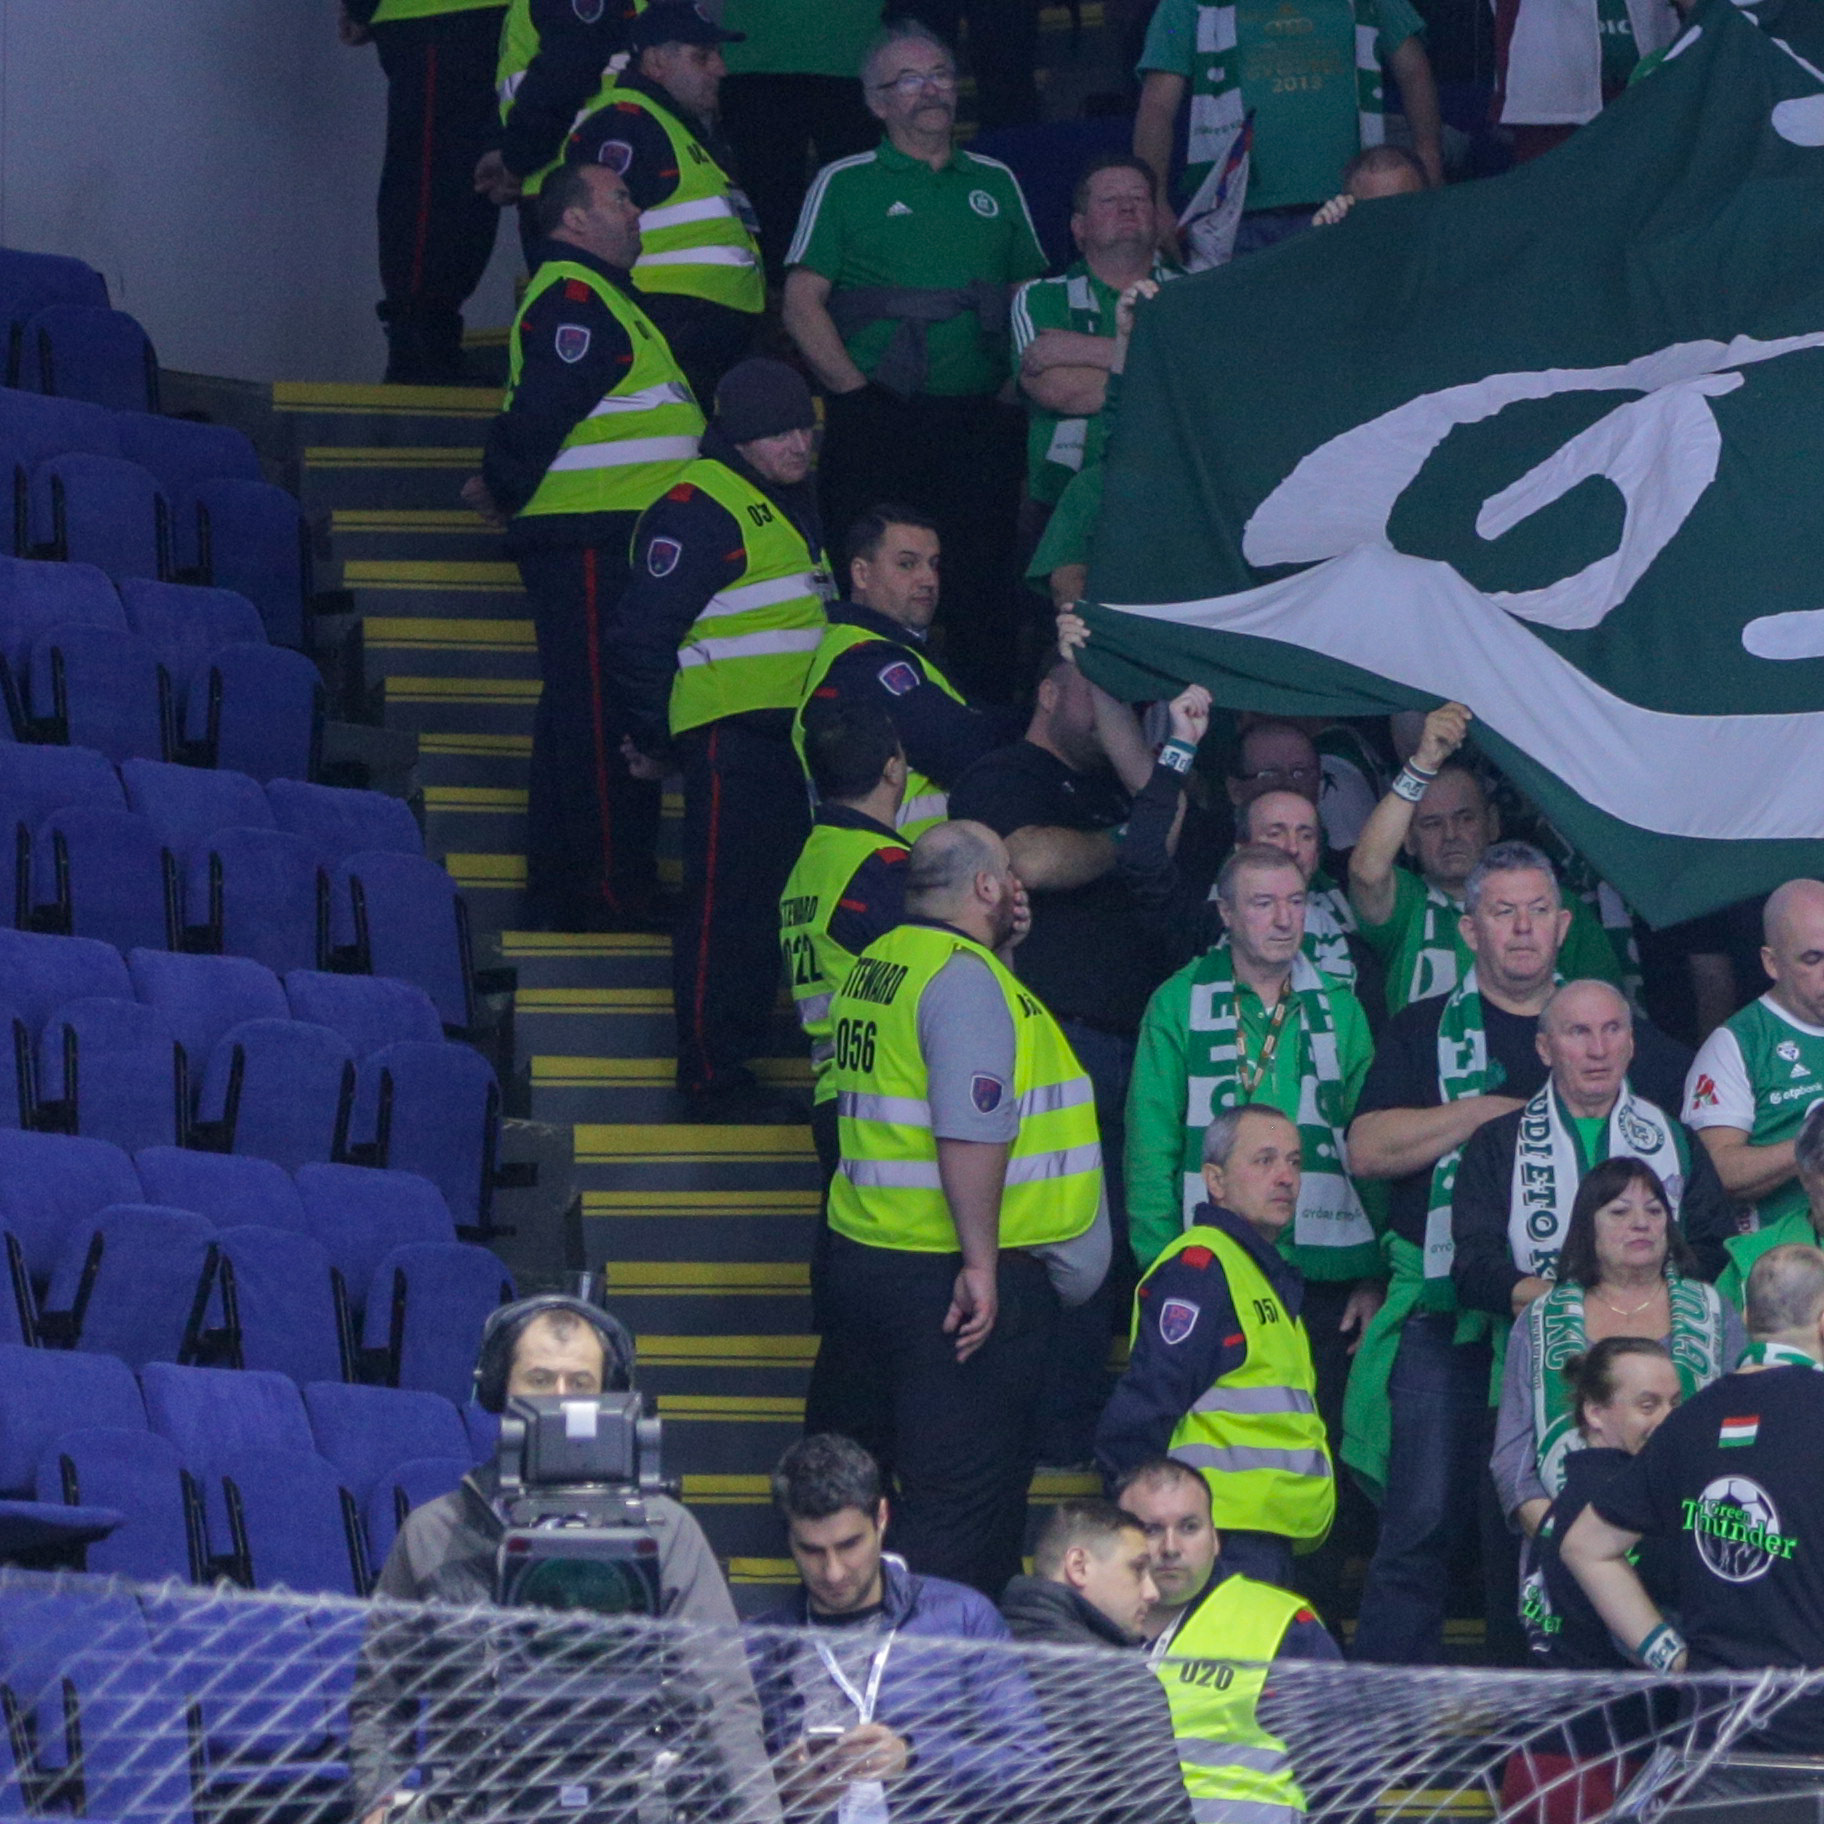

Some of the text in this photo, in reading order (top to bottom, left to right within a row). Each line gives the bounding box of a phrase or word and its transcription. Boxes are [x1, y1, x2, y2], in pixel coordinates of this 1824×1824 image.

[836, 1017, 878, 1074] 056
[1522, 1096, 1553, 1159] UDI
[1522, 1161, 1559, 1242] ETO
[1681, 1498, 1799, 1560] Thunder
[1706, 1499, 1752, 1523] Green
